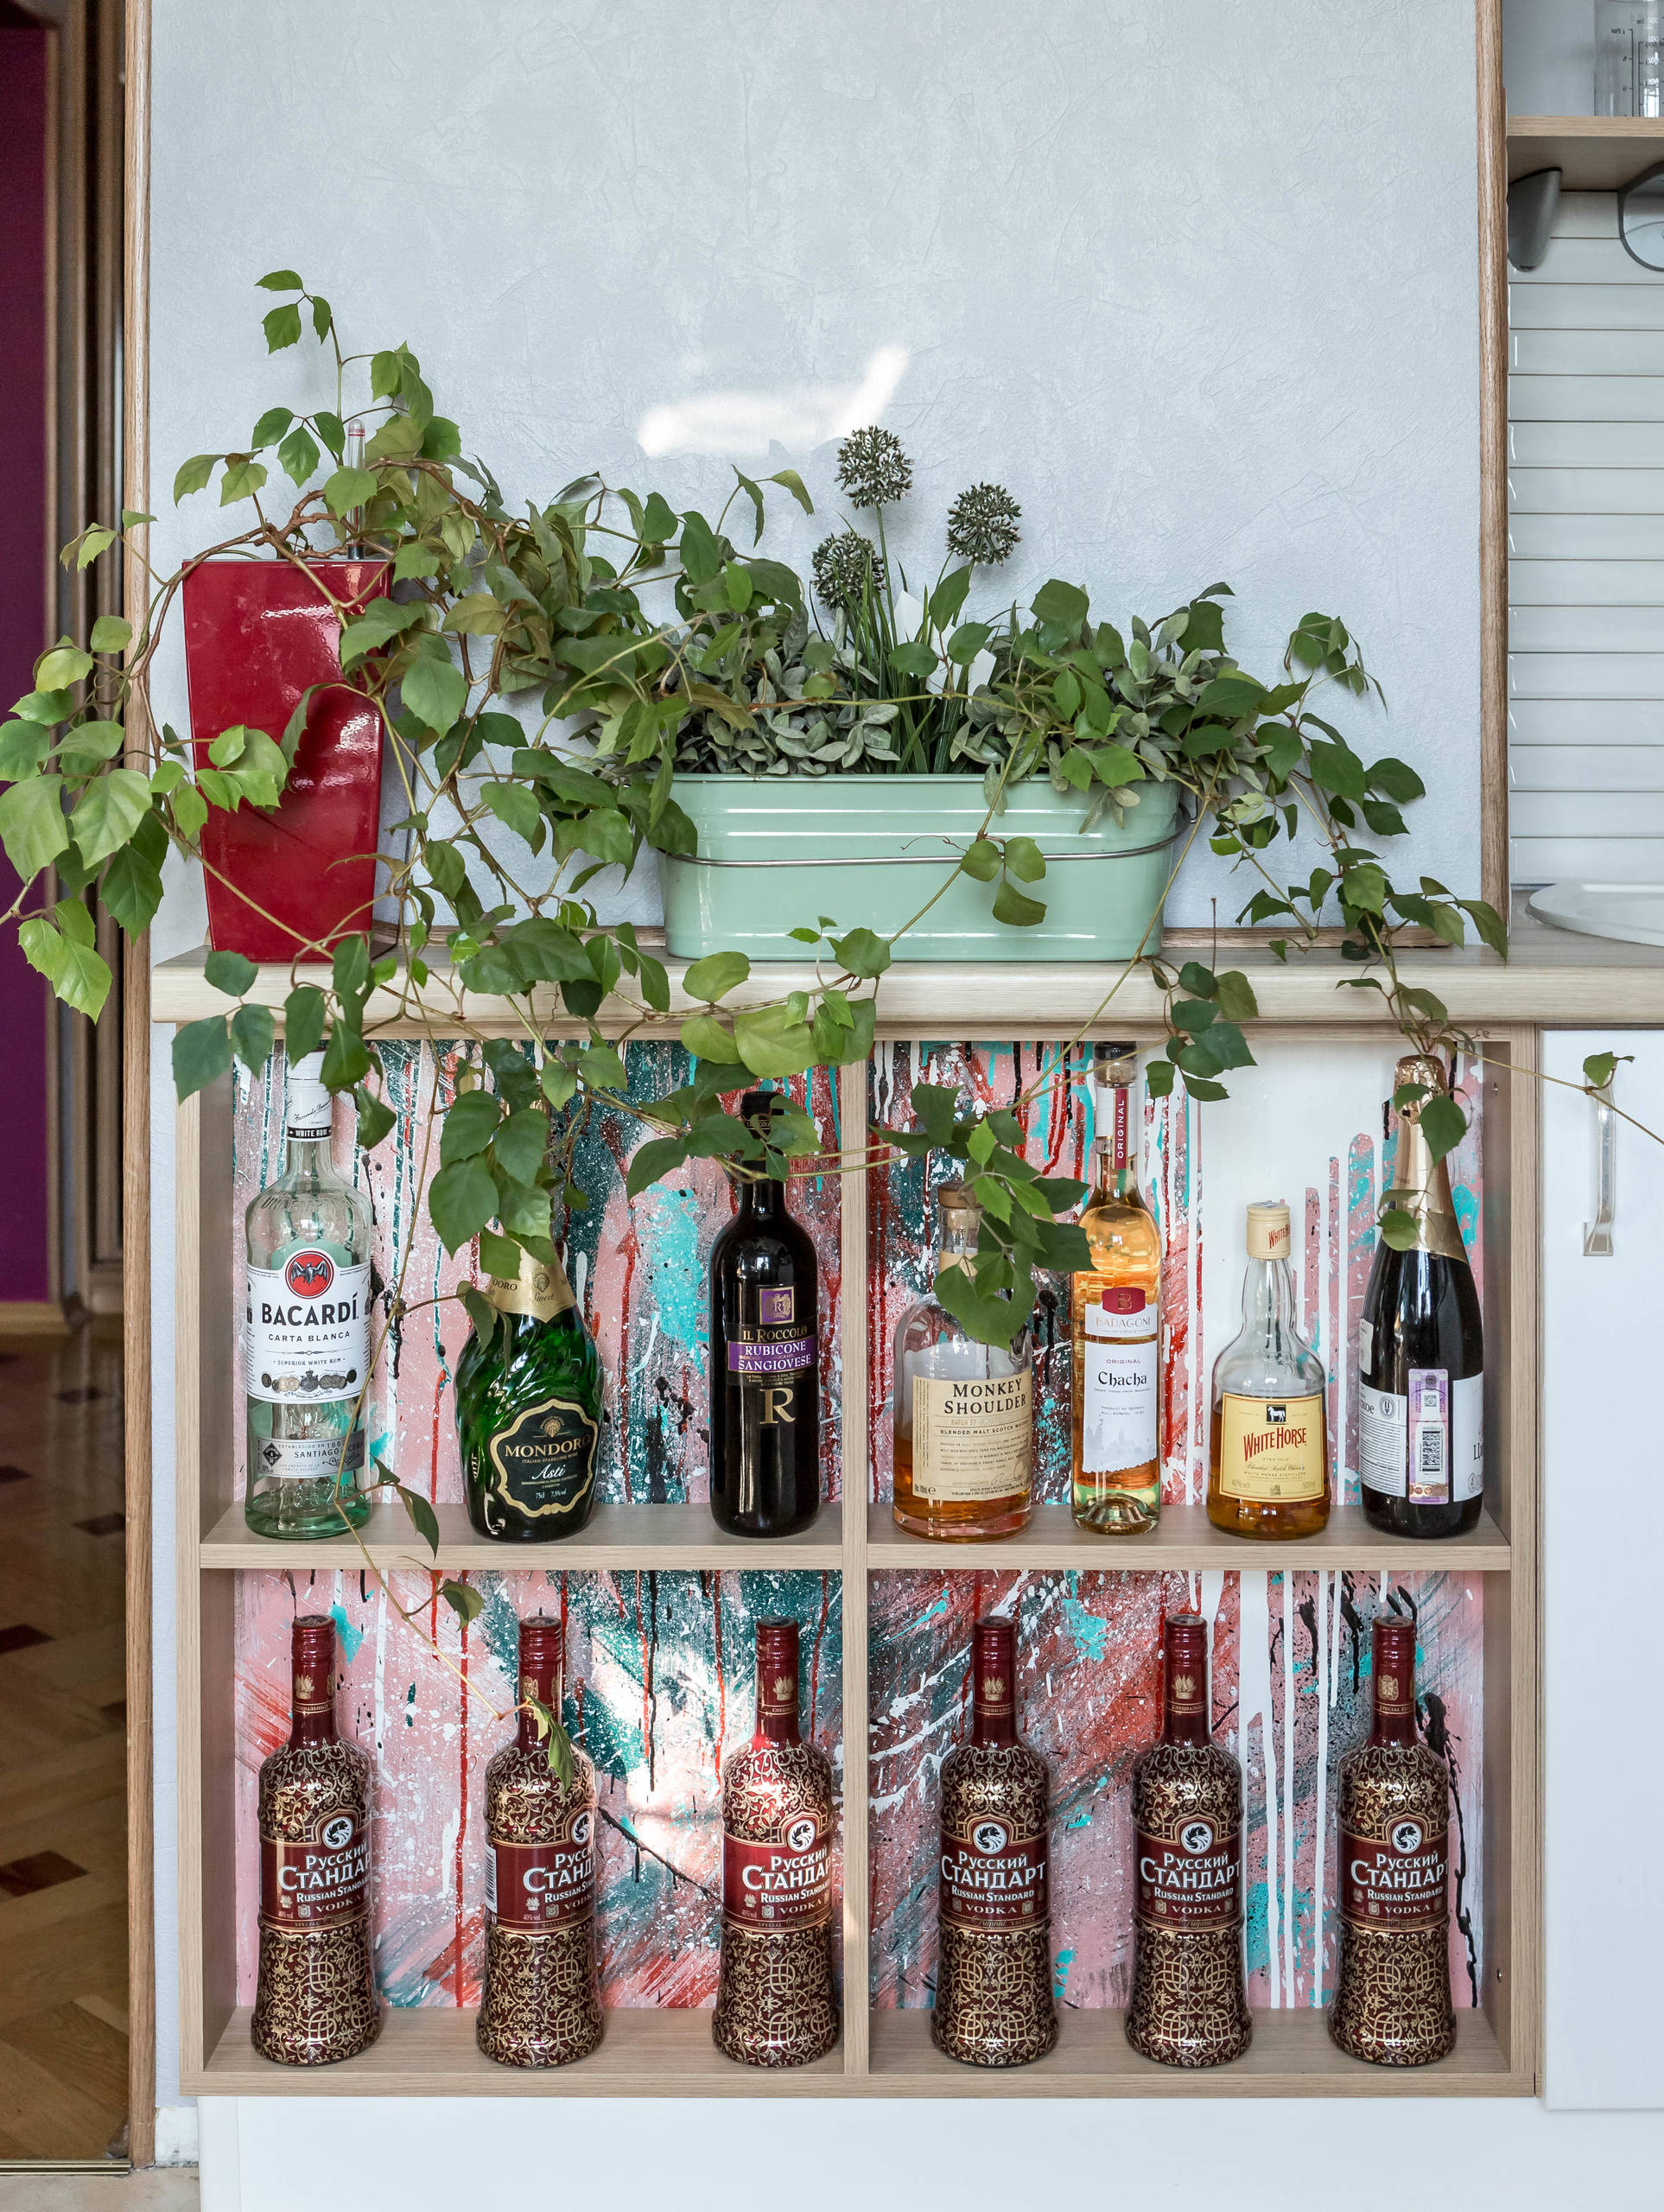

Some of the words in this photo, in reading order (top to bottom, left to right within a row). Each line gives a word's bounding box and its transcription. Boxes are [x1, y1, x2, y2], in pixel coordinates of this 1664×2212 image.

[1268, 1228, 1285, 1249] WHITE
[262, 1291, 358, 1326] BACARDÍ
[268, 1333, 302, 1342] CARTA
[308, 1331, 350, 1342] BLANCA
[743, 1330, 753, 1340] IL
[757, 1325, 807, 1342] ROCCOLO
[745, 1341, 806, 1356] RUBICONE
[738, 1354, 811, 1370] SANGIOVESE
[953, 1378, 1021, 1397] MONKEY
[1098, 1371, 1147, 1388] Chacha
[759, 1387, 797, 1425] R
[944, 1394, 1026, 1414] SHOULDER
[505, 1435, 591, 1458] MONDORO
[1243, 1431, 1275, 1462] WHITE
[1276, 1427, 1307, 1449] HORSE
[295, 1448, 339, 1459] SANTIAGO
[531, 1464, 566, 1480] Asti
[296, 1891, 336, 1903] RUSSIAN
[544, 1887, 581, 1904] RUSSIAN
[760, 1892, 799, 1904] RUSSIAN
[951, 1885, 985, 1901] RUSSIAN
[987, 1890, 1034, 1902] STANDARD
[1154, 1886, 1193, 1901] RUSSIAN
[1195, 1887, 1234, 1903] STANDARD
[1368, 1889, 1403, 1901] RUSSIAN
[1404, 1886, 1444, 1902] STANDARD
[779, 1899, 822, 1915] VODKA
[966, 1904, 1017, 1914] VODKA
[1172, 1905, 1221, 1915] VODKA
[1384, 1904, 1431, 1915] VODKA
